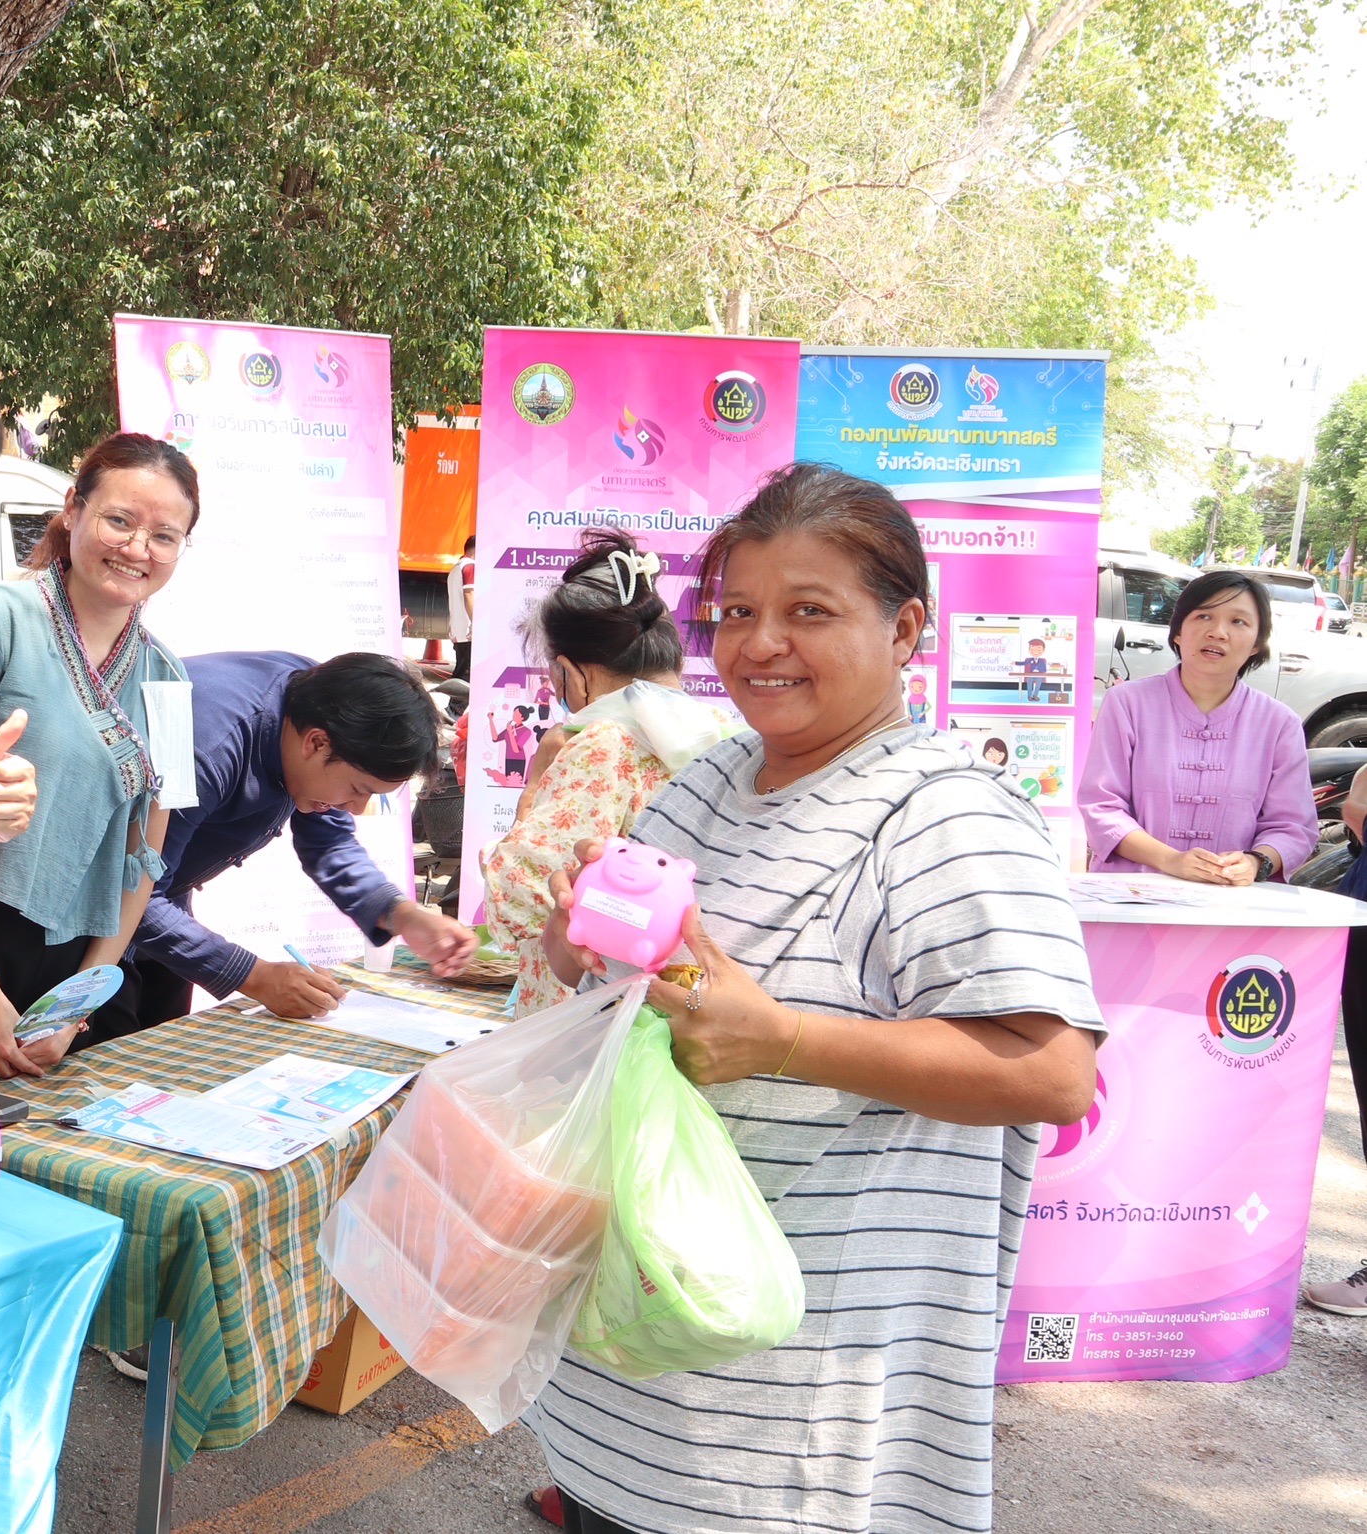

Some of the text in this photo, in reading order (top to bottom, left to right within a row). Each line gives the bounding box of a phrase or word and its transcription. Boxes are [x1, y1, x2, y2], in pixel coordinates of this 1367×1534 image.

[840, 423, 1058, 449] กองทุนพัฒนาบทบาทสตรี
[437, 451, 459, 475] รักษา
[876, 451, 1022, 473] จังหวัดฉะเชิงเทรา
[510, 550, 578, 567] 1.ประเภท
[1197, 1032, 1298, 1070] กรมการพัฒนาชุมชน
[1076, 1202, 1231, 1222] จังหวัดฉะเชิงเทรา
[1089, 1306, 1271, 1326] สำนักงานพัฒนาชุมชนจังหวัดฉะเชิงเทรา
[1086, 1328, 1184, 1342] โทร. 0-3851-3460
[1083, 1346, 1196, 1359] โทรสาร 0-3851-1239
